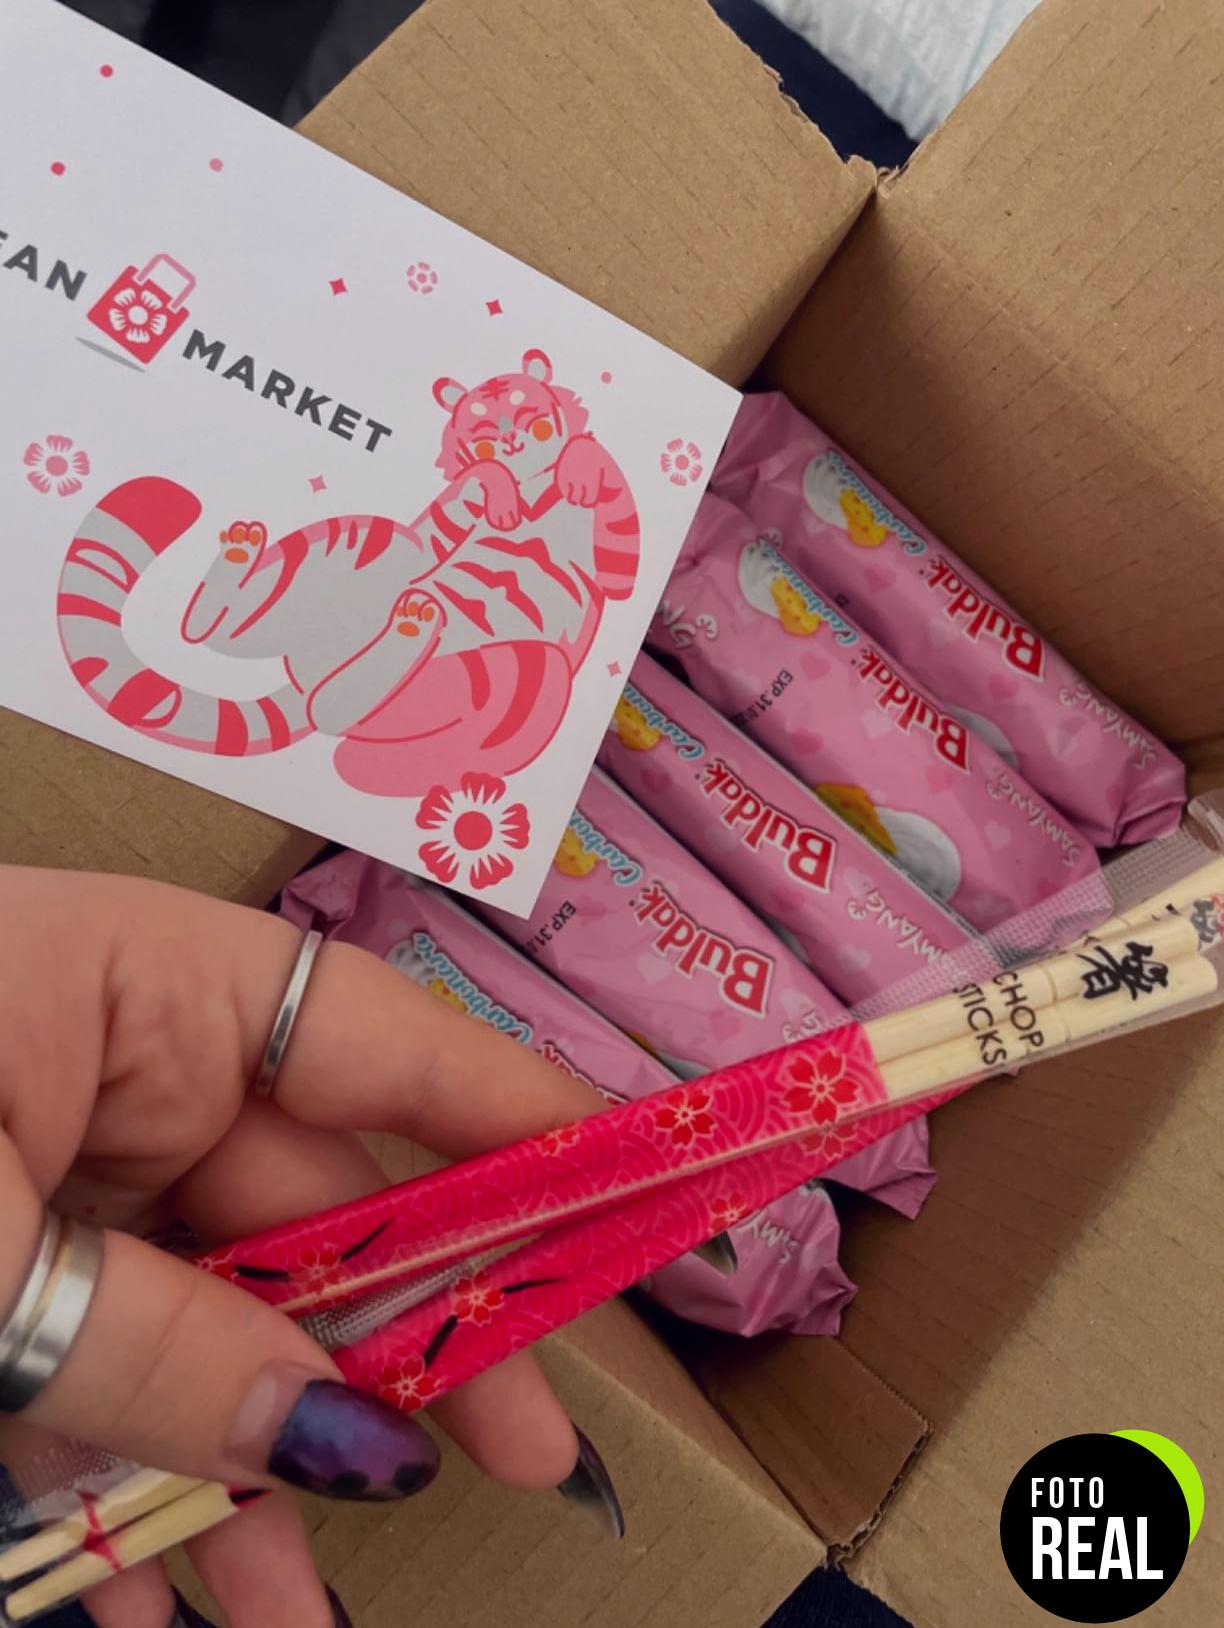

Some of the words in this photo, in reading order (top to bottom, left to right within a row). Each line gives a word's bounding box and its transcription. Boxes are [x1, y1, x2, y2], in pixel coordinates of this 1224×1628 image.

[0, 229, 88, 301] AN
[182, 328, 393, 453] MARKET
[927, 557, 1045, 683] Buldak
[858, 647, 972, 775] Buldak
[701, 758, 837, 893] Buldak
[412, 931, 534, 1044] Carbonara
[635, 880, 774, 1018] Buldak
[993, 971, 1045, 1048] CHOP
